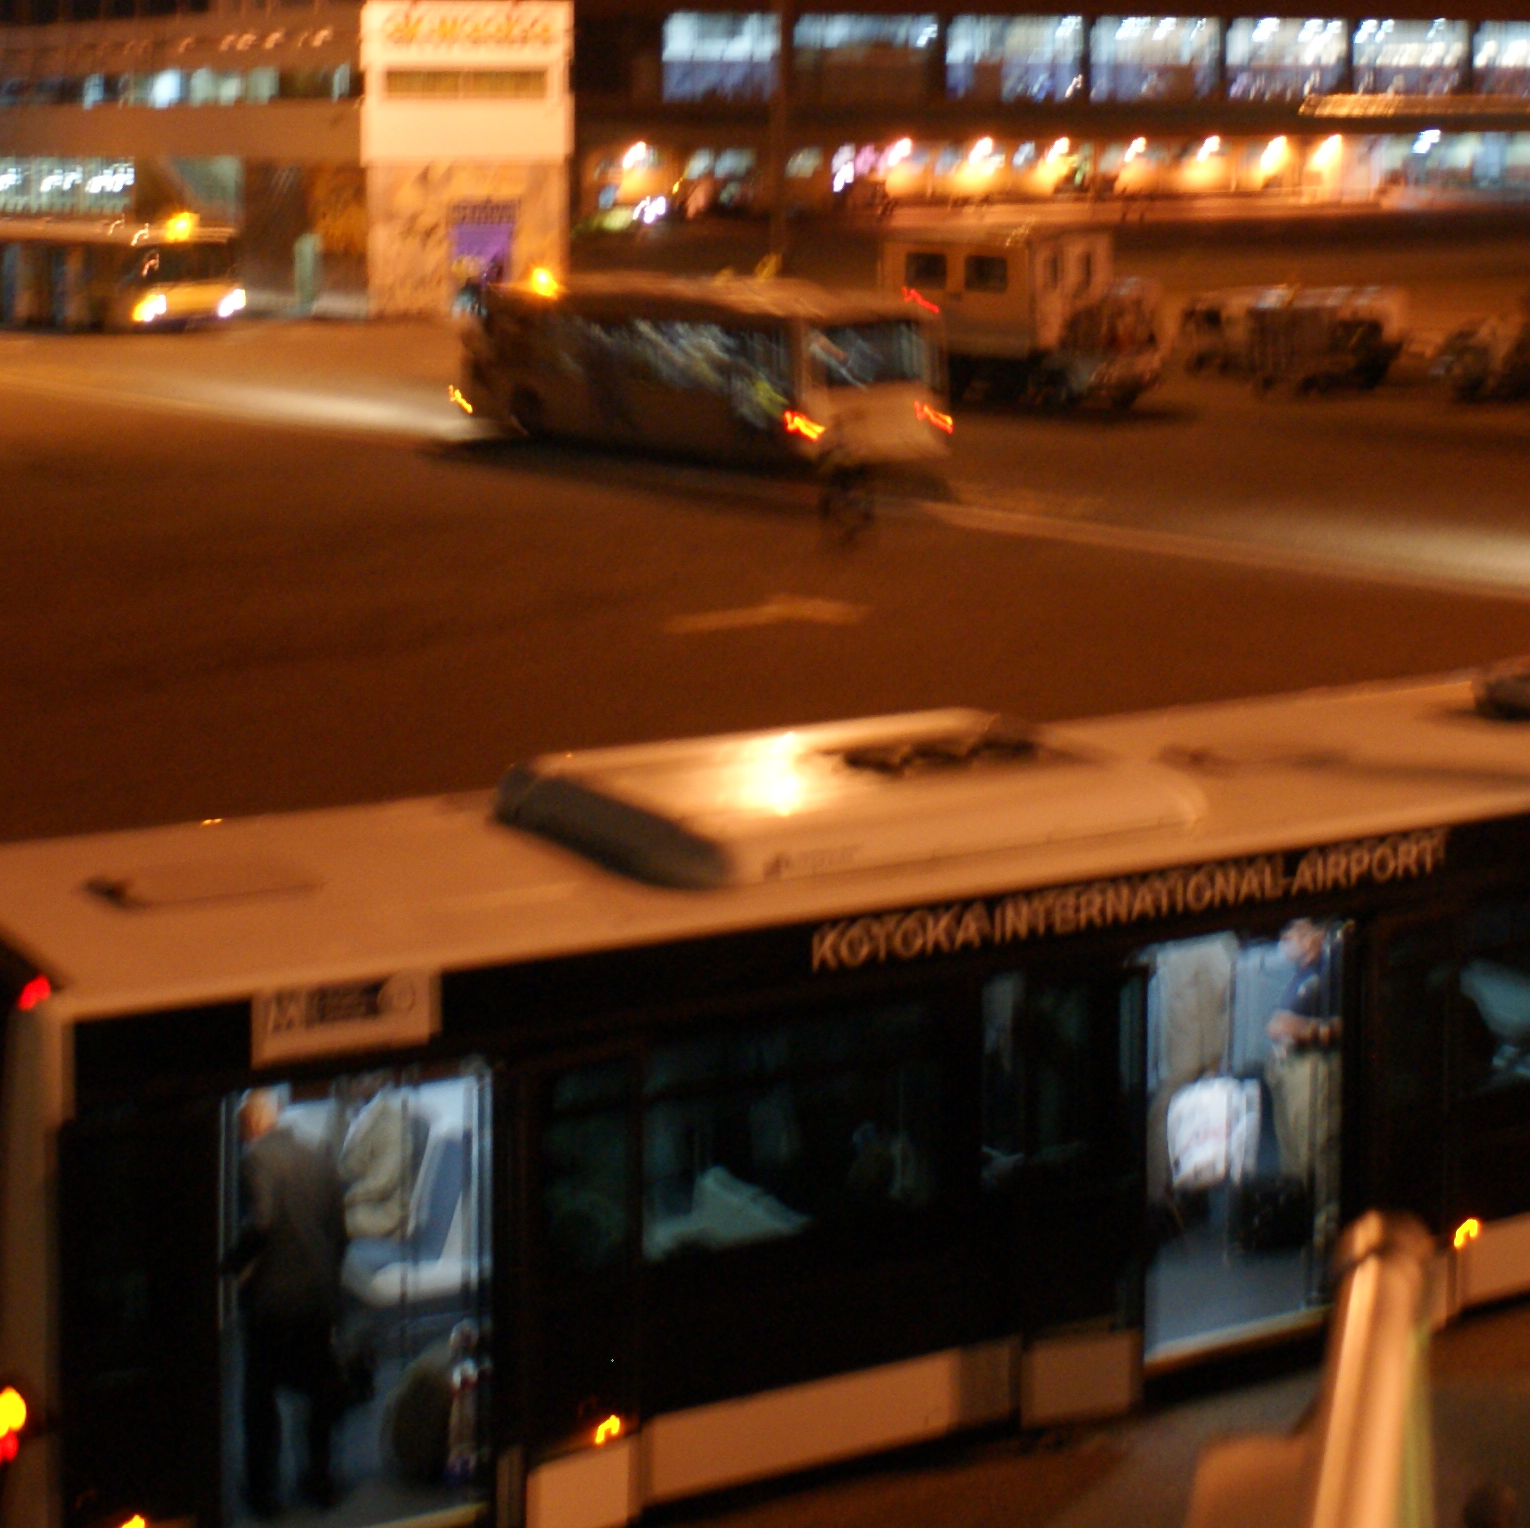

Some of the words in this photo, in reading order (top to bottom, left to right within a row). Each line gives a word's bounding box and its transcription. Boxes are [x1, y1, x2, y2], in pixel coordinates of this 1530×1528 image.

[811, 904, 990, 973] KOTOKA
[993, 857, 1285, 942] INTERNATIONAL
[1291, 831, 1445, 896] AIRPORT
